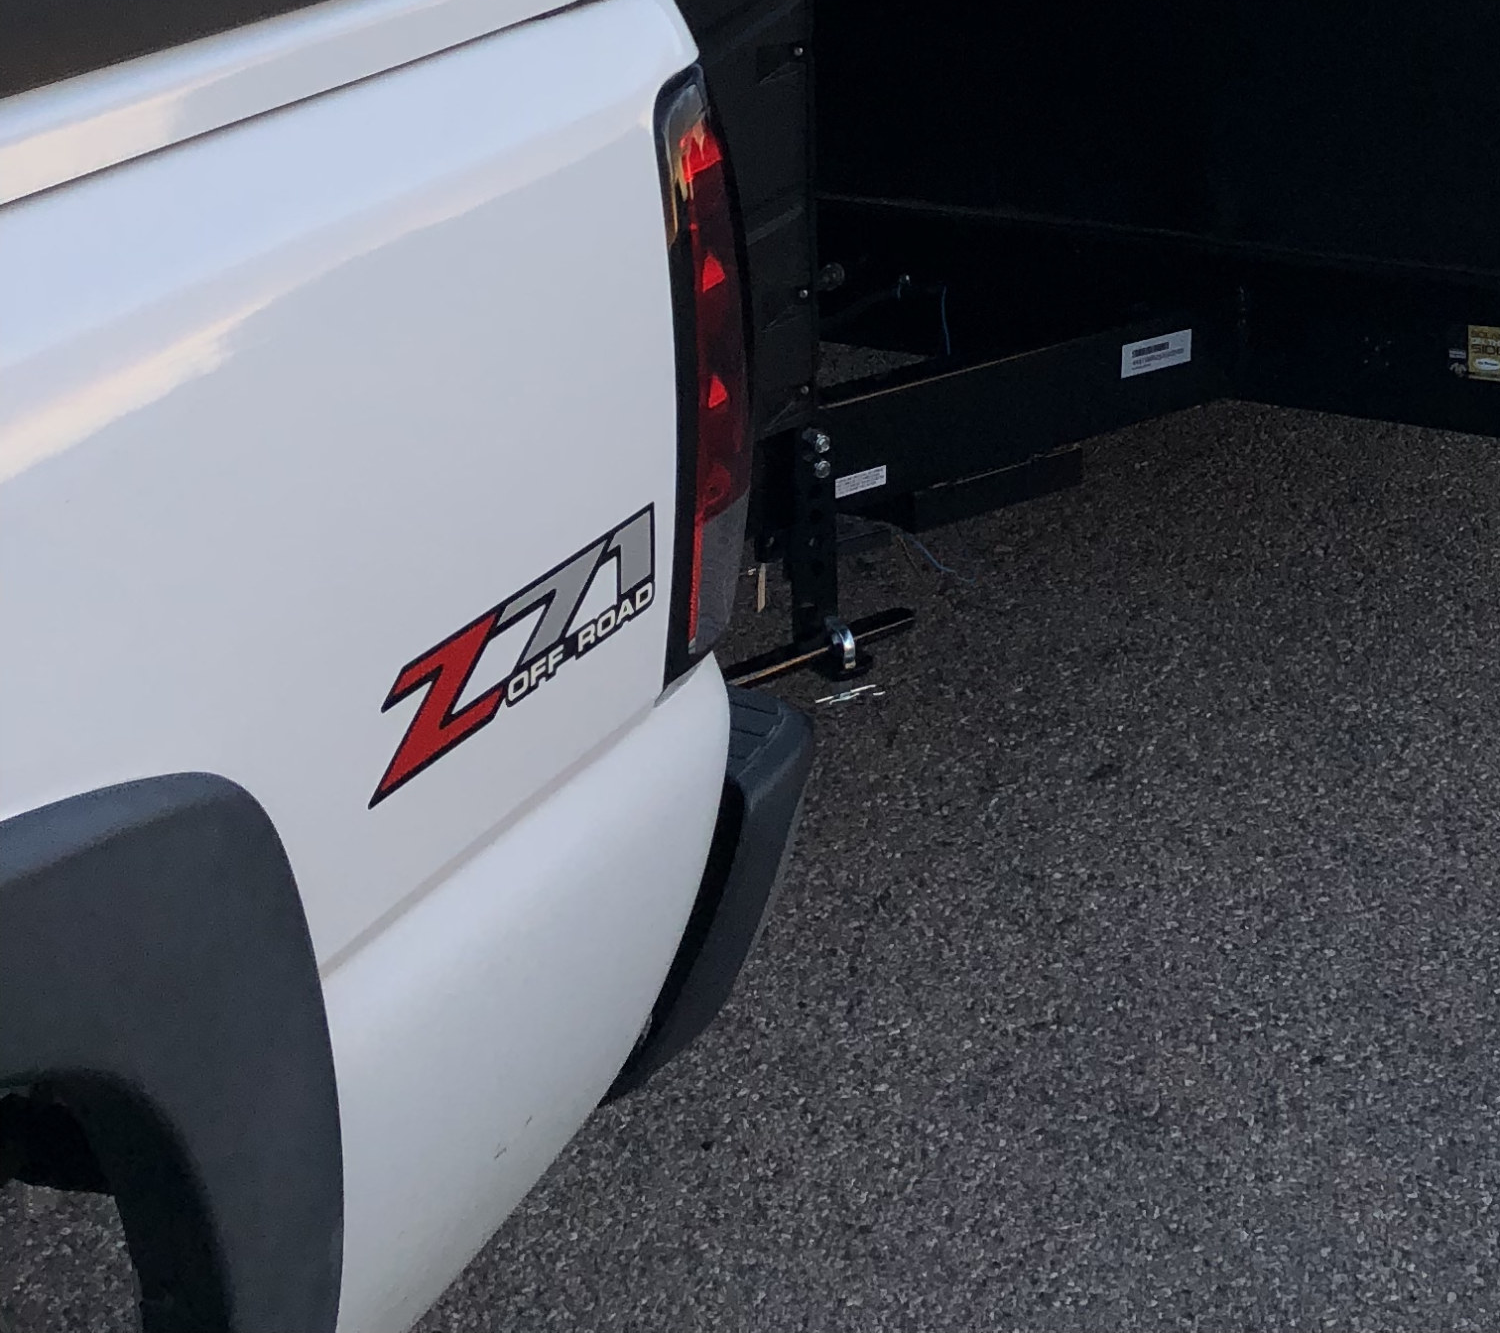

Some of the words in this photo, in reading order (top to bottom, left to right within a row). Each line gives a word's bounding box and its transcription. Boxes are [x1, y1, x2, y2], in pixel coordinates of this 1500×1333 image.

[367, 501, 655, 811] Z71
[506, 643, 566, 703] OFF
[577, 581, 653, 654] ROAD
